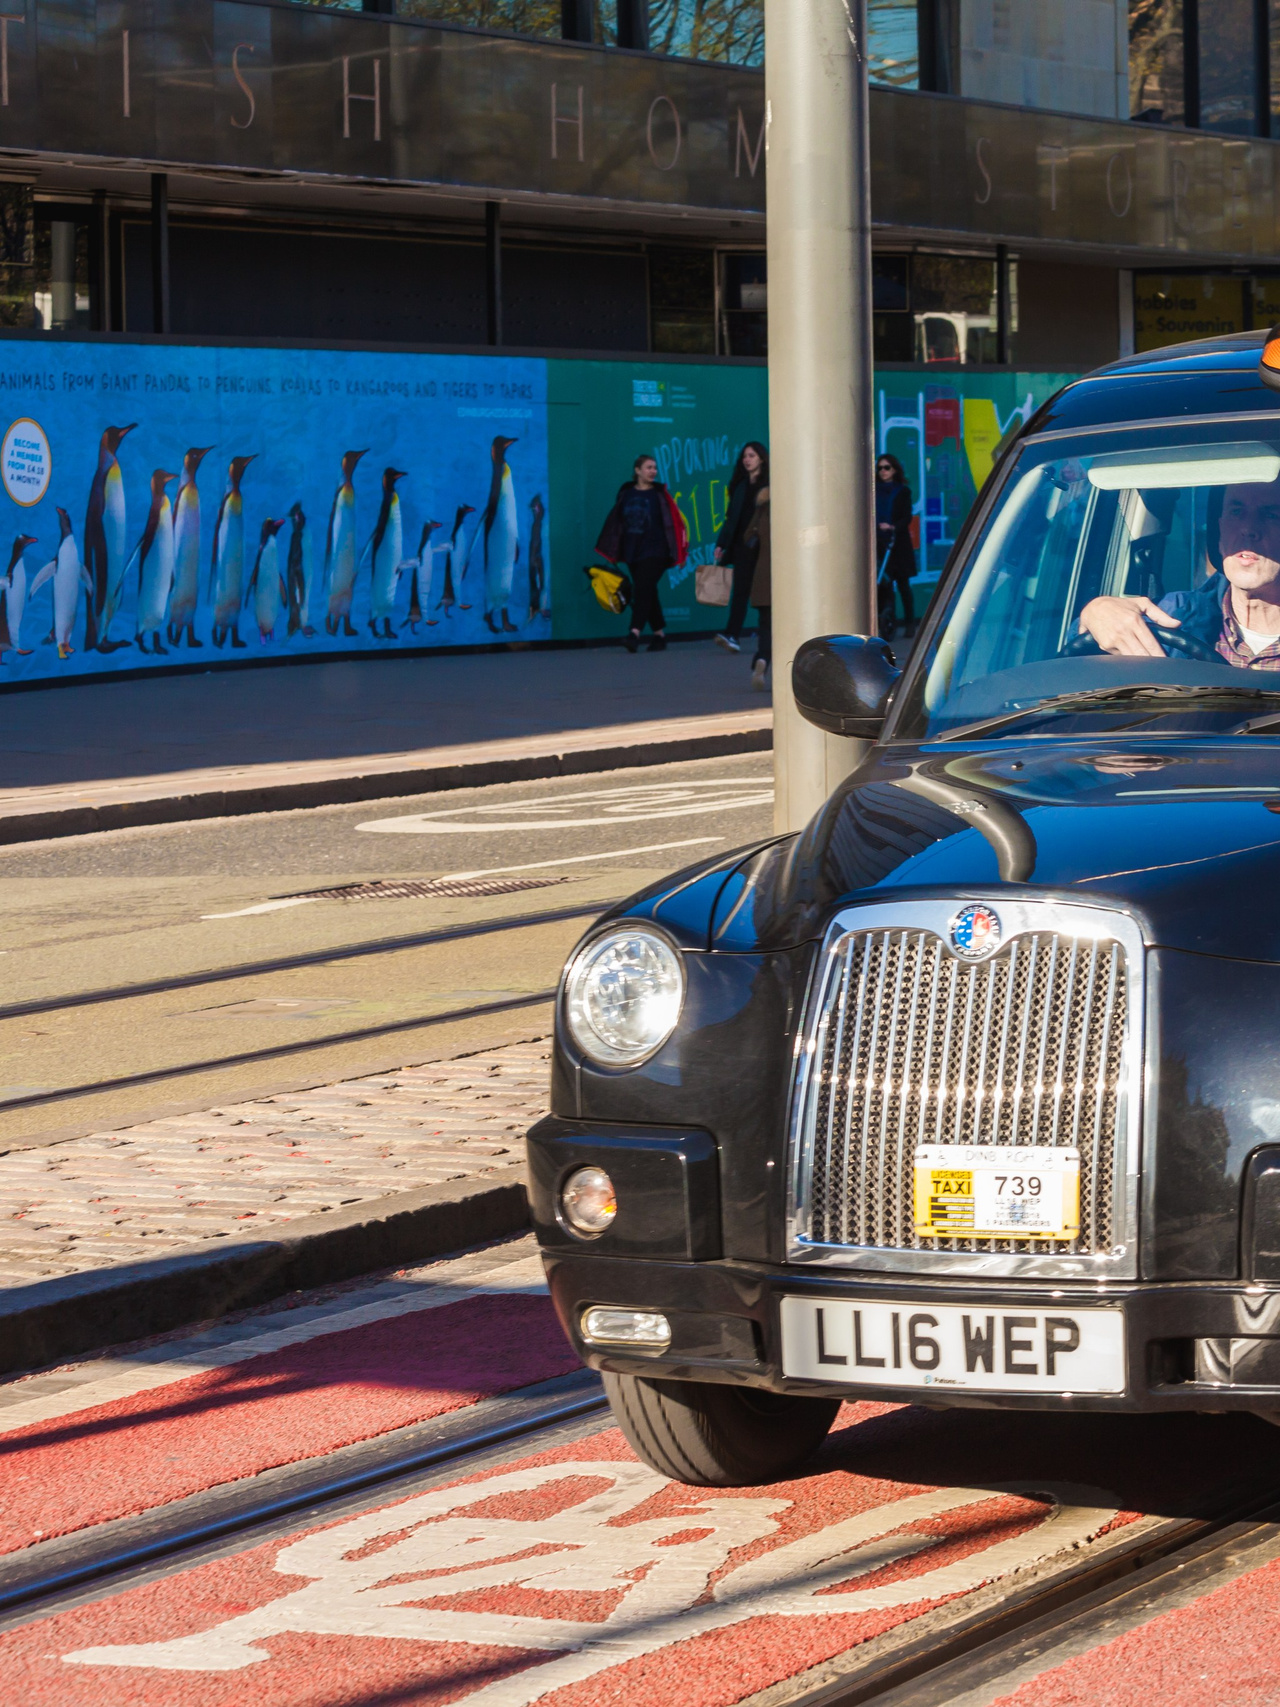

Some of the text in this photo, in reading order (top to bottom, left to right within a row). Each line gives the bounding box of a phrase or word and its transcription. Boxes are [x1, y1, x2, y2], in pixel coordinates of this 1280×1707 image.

[1157, 316, 1235, 333] Souvenirs
[0, 372, 54, 392] ANIMALS
[62, 372, 95, 392] FROM
[102, 372, 138, 392] GIANT
[145, 374, 190, 394] PANDAS
[198, 375, 211, 391] TO
[346, 378, 410, 398] KANGAROOS
[414, 380, 437, 398] AND
[932, 1176, 1042, 1196] TAXI 739
[815, 1307, 1080, 1376] LL16 WEP
